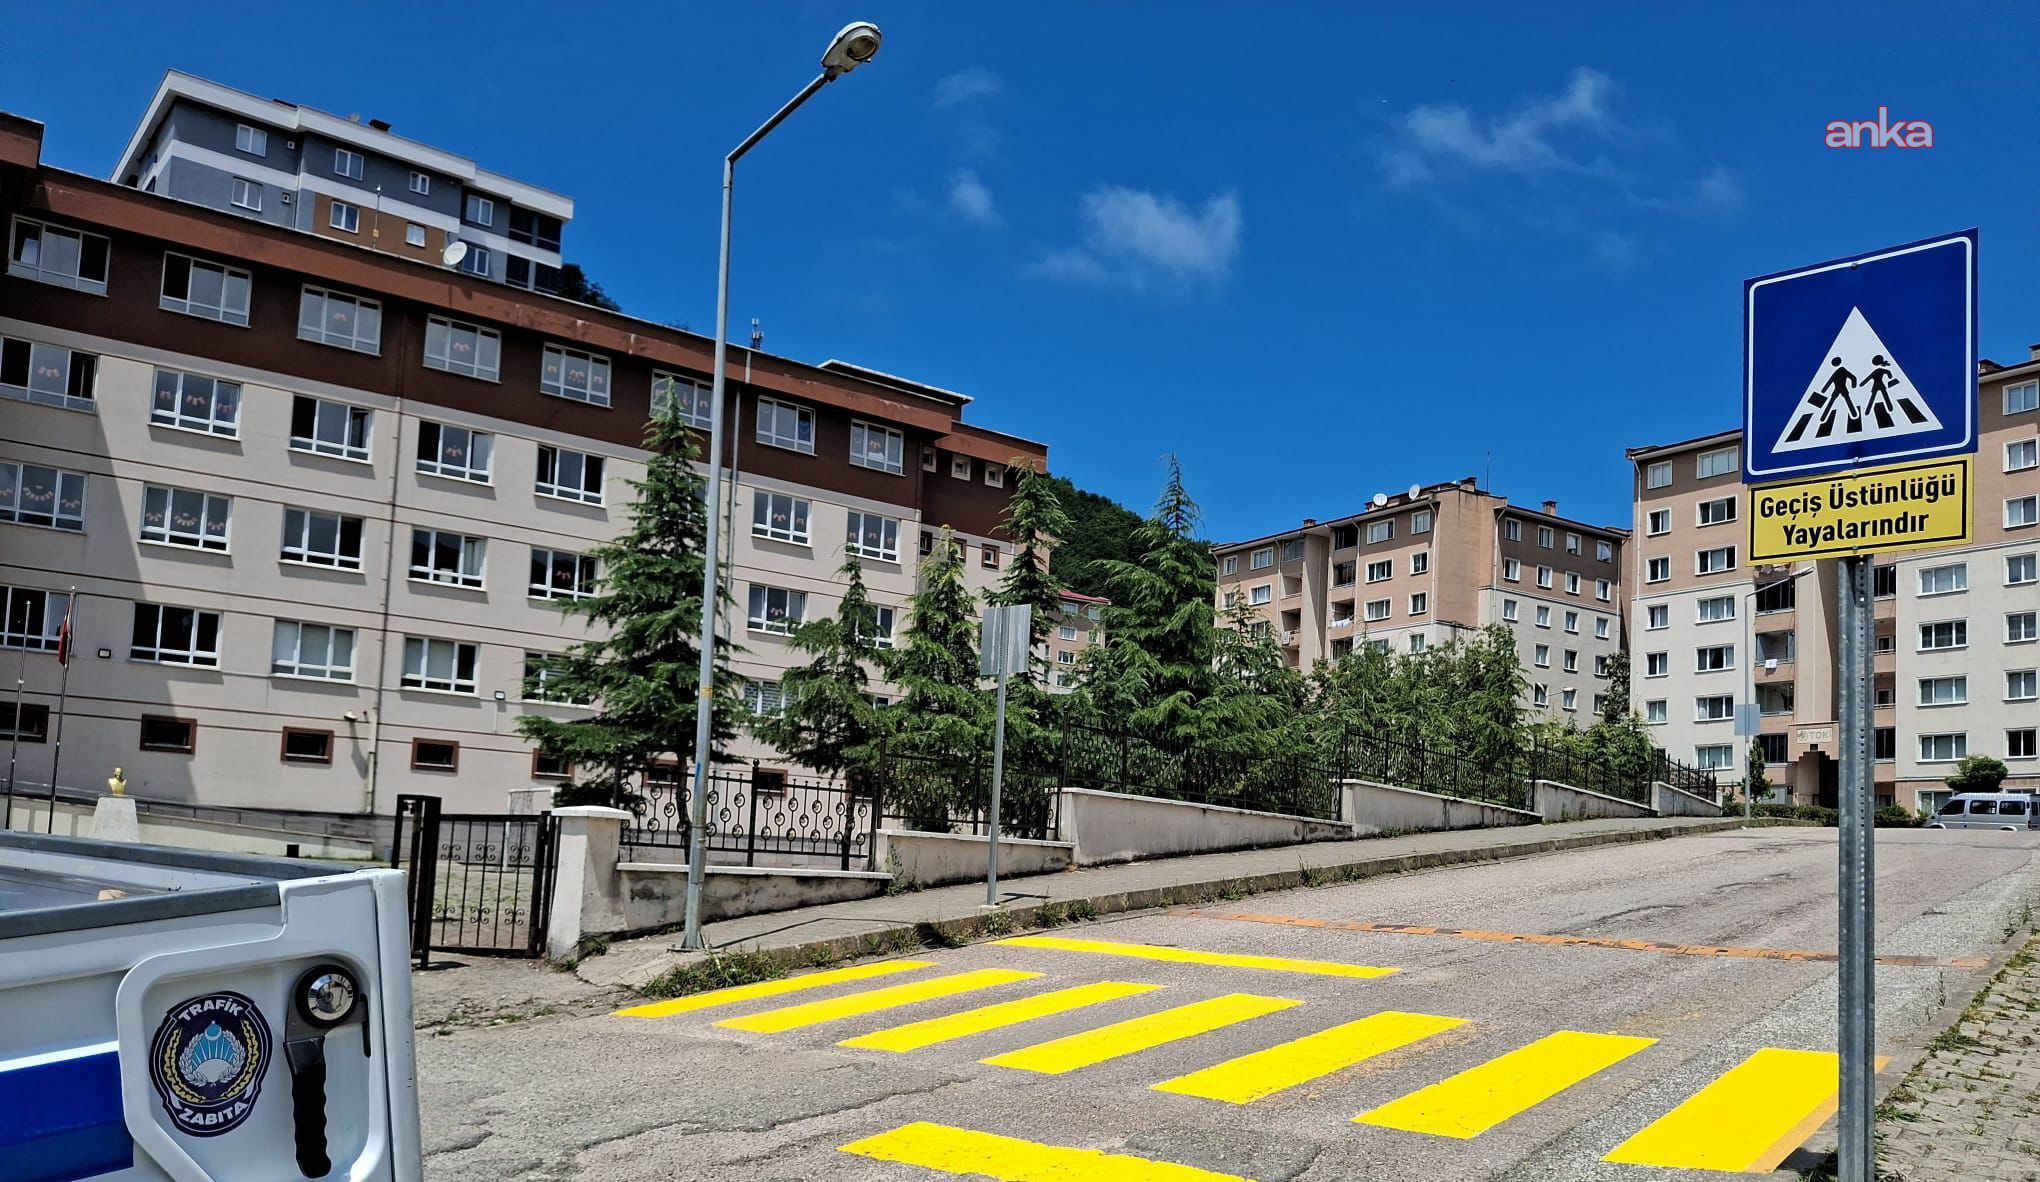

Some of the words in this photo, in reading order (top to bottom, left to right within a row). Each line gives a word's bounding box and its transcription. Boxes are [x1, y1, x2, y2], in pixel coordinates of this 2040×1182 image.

[1760, 492, 1822, 520] Geçiş
[1829, 473, 1956, 510] Üstünlüğü
[1783, 511, 1930, 548] Yayalarındır
[178, 998, 244, 1022] TRAFİK
[178, 1100, 249, 1125] ZABITA
